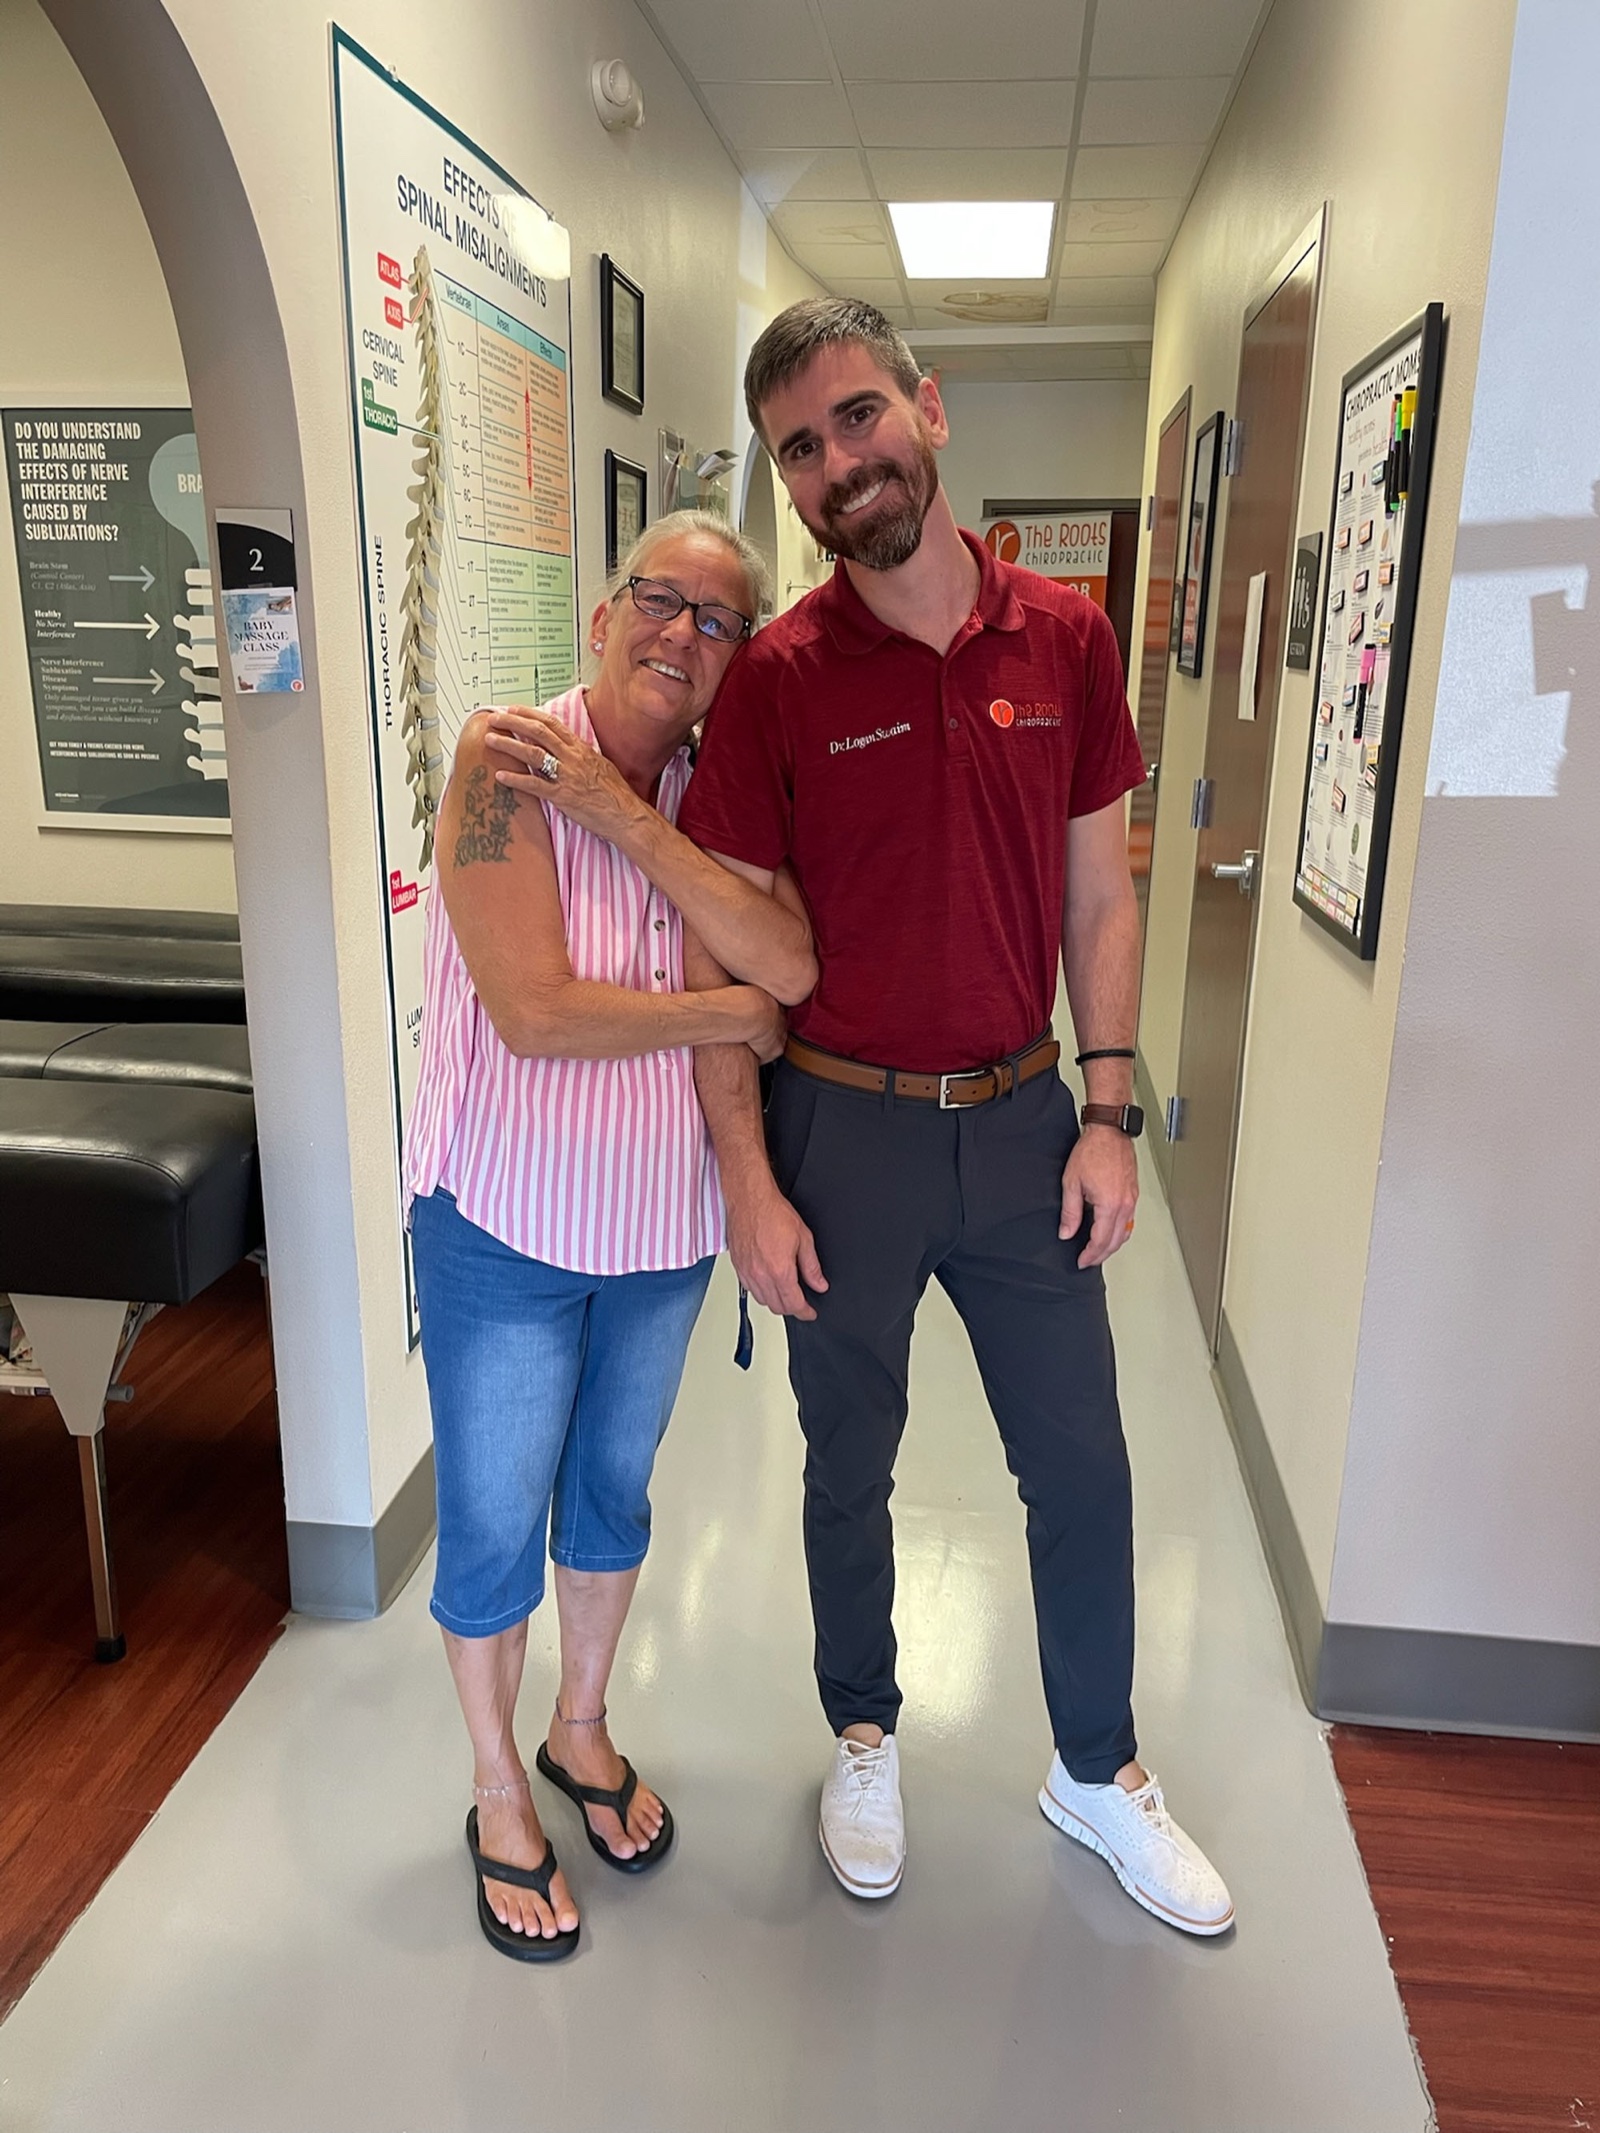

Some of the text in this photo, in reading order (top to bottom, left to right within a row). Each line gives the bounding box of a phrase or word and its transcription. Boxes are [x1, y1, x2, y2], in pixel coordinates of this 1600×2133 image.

[443, 156, 500, 230] EFFECTS
[397, 174, 547, 308] SPINAL MISALIGNMENTS
[380, 259, 400, 282] ATLAS
[387, 303, 401, 323] AXIS
[363, 328, 404, 364] CERVICAL
[373, 360, 398, 387] SPINE
[363, 385, 373, 401] 1st
[458, 381, 467, 396] 2C
[1346, 366, 1395, 422] CHIROPRACTIC
[364, 406, 397, 430] THORACIC
[460, 414, 468, 429] 3C
[15, 422, 141, 440] DO YOU UNDERSTAND
[16, 443, 106, 460] THE DAMAGING
[19, 463, 129, 481] EFFECTS OF NERVE
[462, 463, 471, 478] 5C
[21, 483, 107, 501] INTERFERENCE
[23, 504, 87, 521] CAUSED BY
[25, 523, 119, 542] SUBLUXATIONS?
[249, 548, 264, 571] 2
[35, 609, 61, 619] Healthy
[36, 620, 66, 628] No Nerve
[244, 621, 274, 631] BABY
[37, 630, 76, 639] Interference
[235, 631, 289, 641] MASSAGE
[374, 535, 393, 731] THORACIC SPINE
[243, 642, 280, 652] CLASS
[40, 657, 104, 667] Nerve Interference
[42, 675, 67, 683] Disease
[43, 683, 79, 693] Symptoms
[393, 888, 416, 909] LUMBAR
